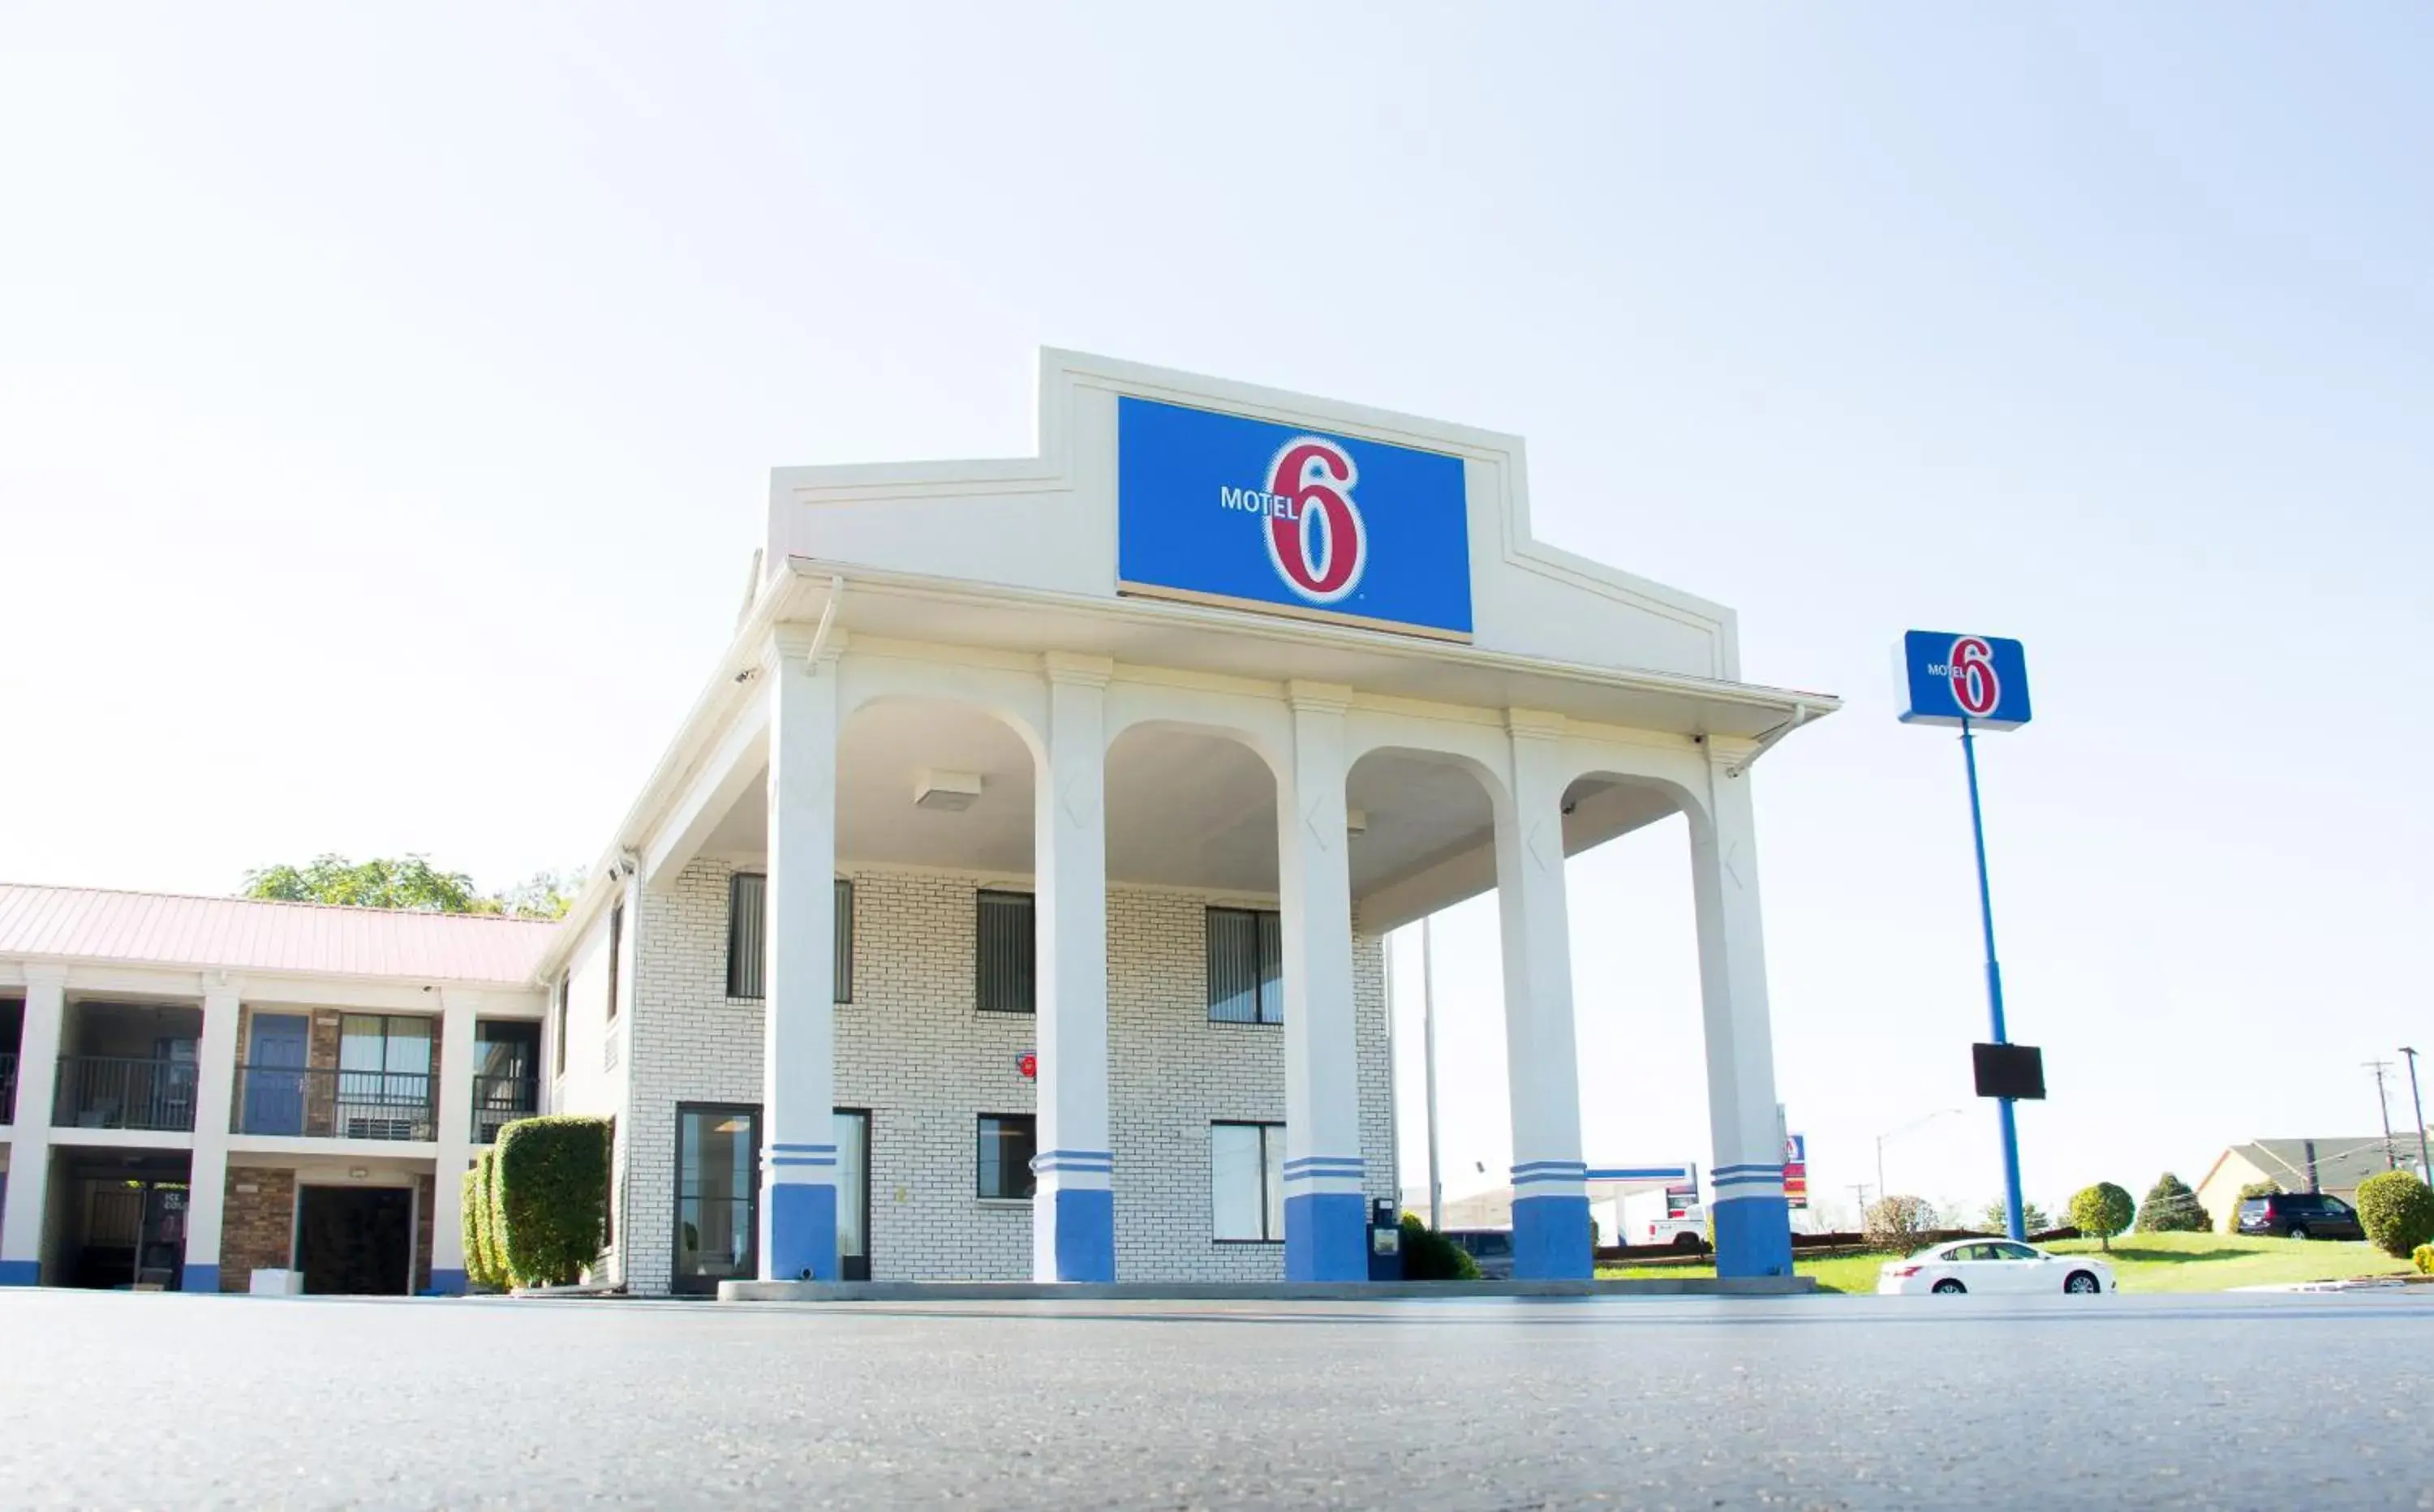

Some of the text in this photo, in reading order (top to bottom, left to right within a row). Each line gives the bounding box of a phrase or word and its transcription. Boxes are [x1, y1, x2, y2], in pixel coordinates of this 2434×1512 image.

[1220, 440, 1362, 599] MOTEL 6
[1928, 637, 1998, 716] MOTEL 6
